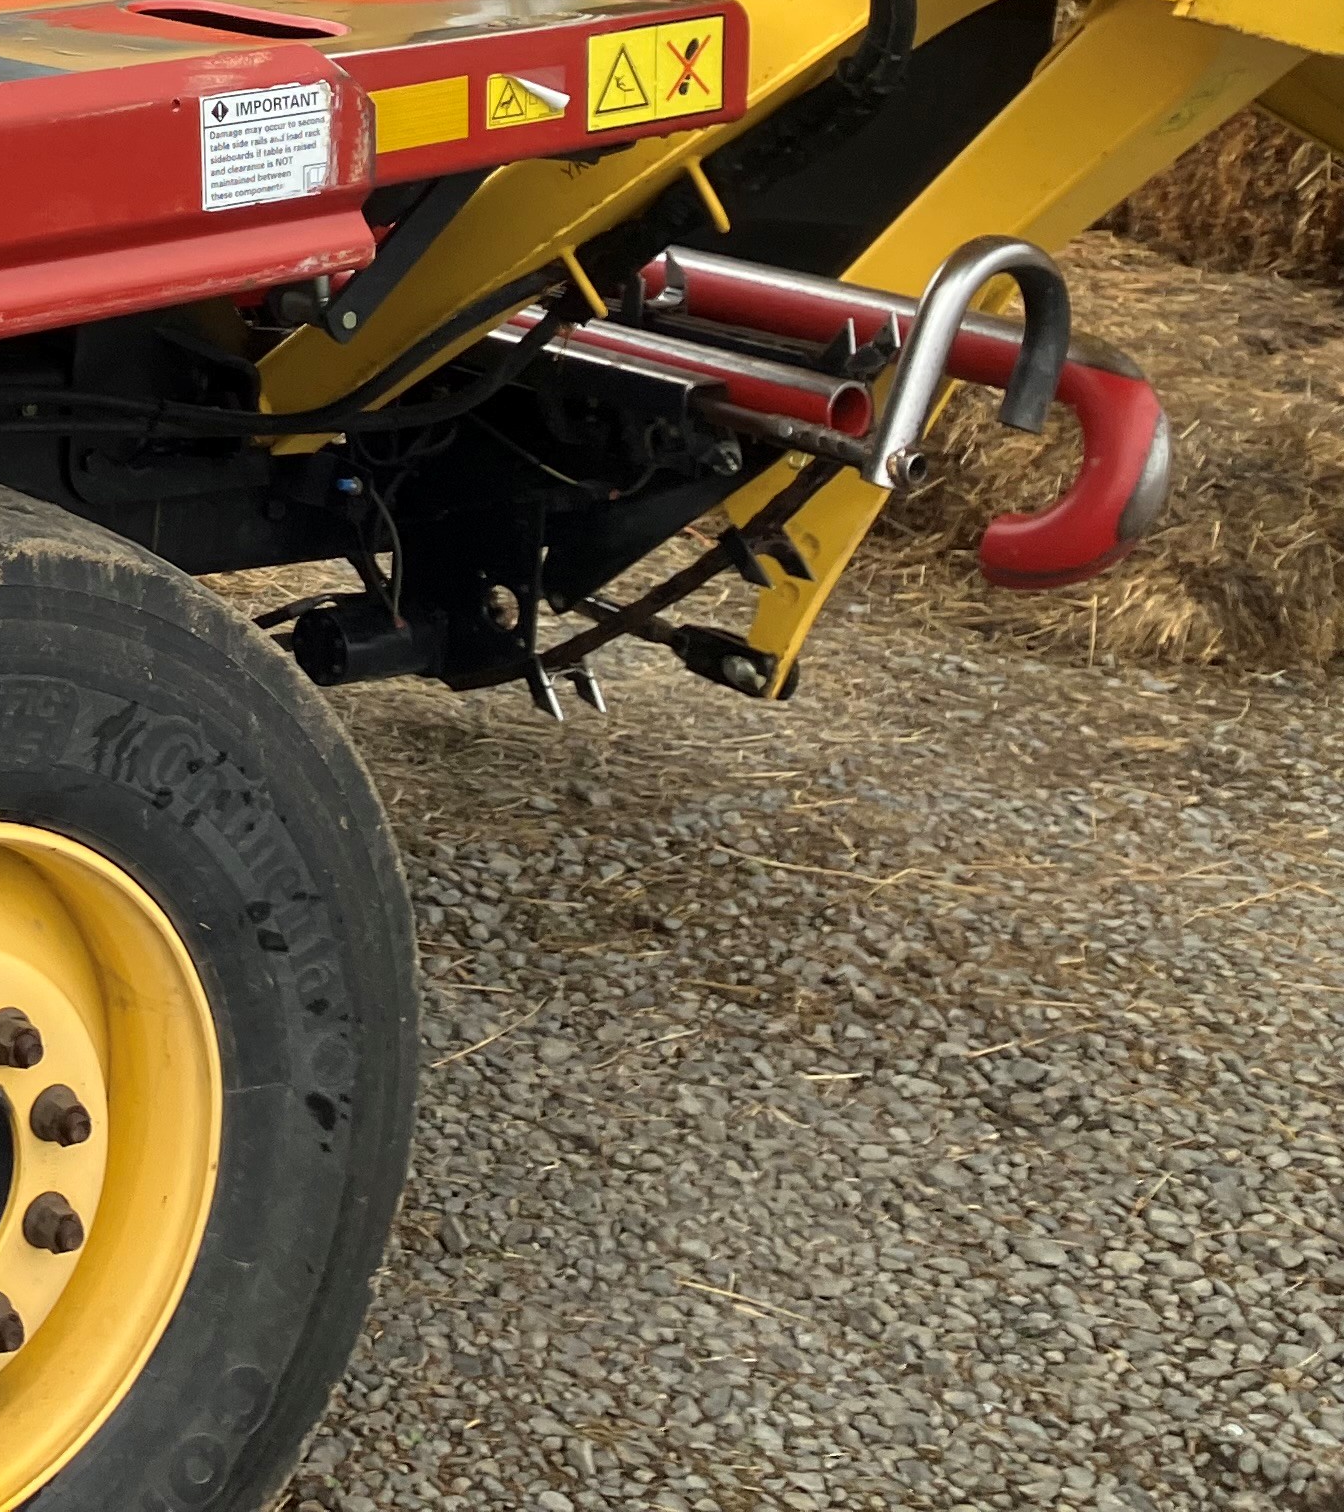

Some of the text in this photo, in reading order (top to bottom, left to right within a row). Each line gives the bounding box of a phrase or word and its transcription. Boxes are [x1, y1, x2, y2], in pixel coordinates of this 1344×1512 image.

[236, 92, 319, 116] IMPORTANT
[210, 116, 325, 139] Damage may occur to second
[210, 129, 320, 152] table side rails and load rack
[211, 142, 316, 164] sideboards if table is raised
[211, 156, 293, 176] and clearance is NOT
[211, 170, 291, 188] maintained between
[211, 191, 232, 201] these
